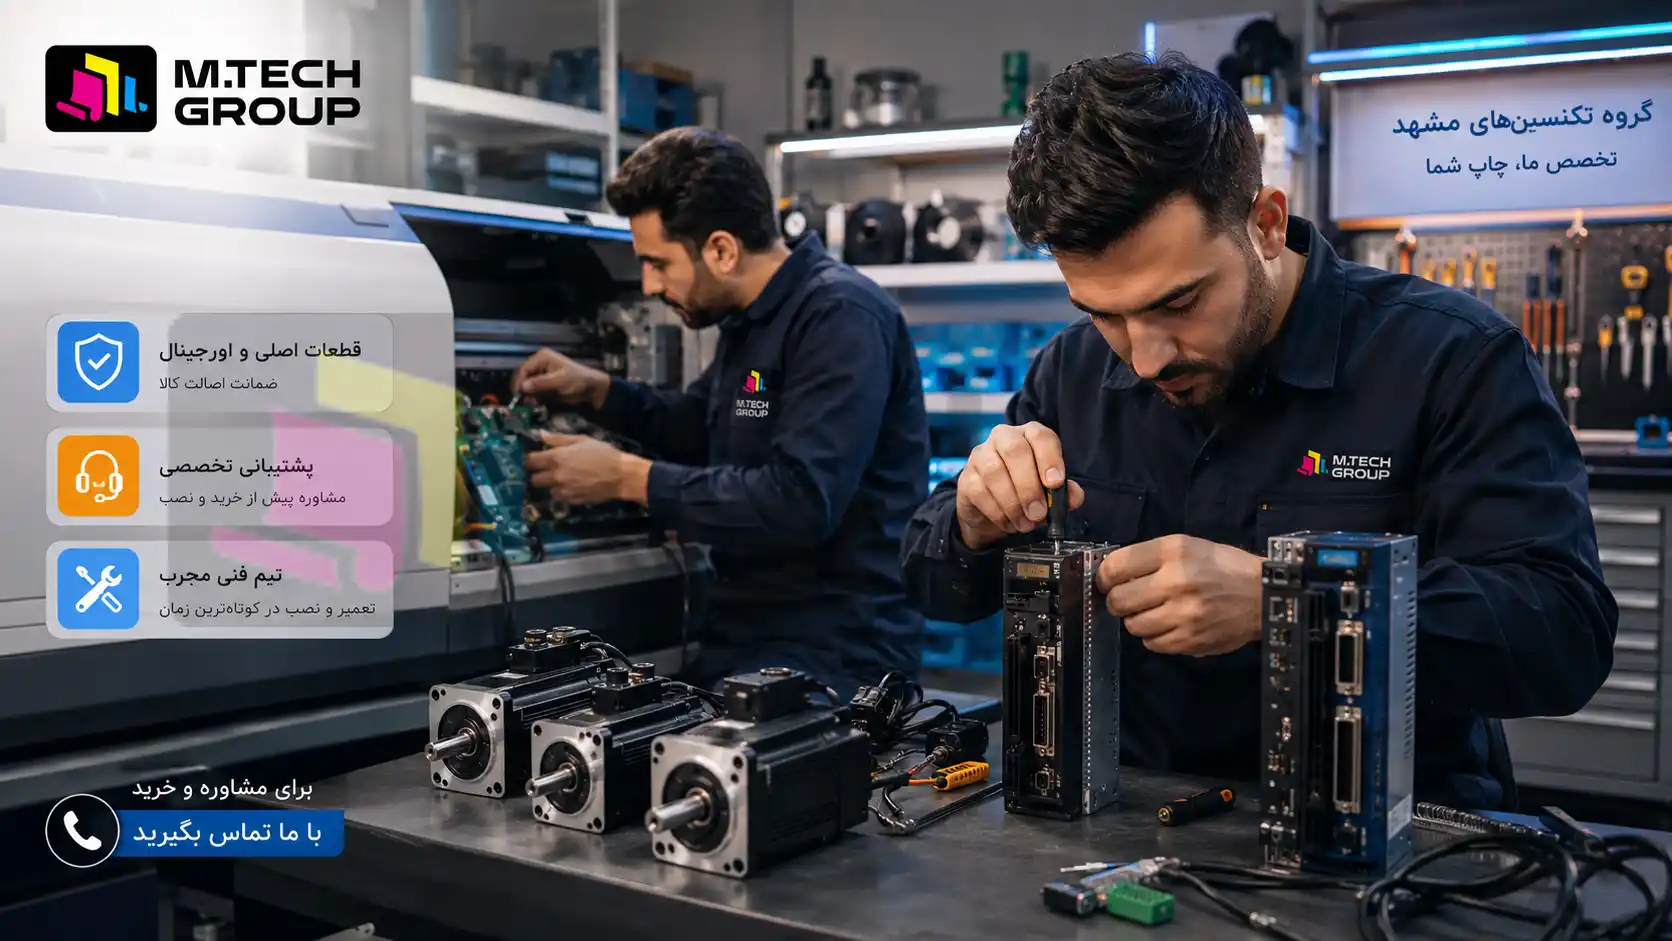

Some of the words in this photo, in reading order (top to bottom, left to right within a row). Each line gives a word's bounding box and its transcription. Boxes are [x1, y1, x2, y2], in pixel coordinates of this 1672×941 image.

[1602, 99, 1653, 130] گروه
[1392, 112, 1460, 139] مشهد
[1426, 156, 1461, 175] شما
[1468, 155, 1508, 179] چاپ
[1515, 154, 1539, 171] ما،
[1546, 151, 1617, 174] تخصص
[736, 408, 769, 417] GROUP
[1332, 454, 1391, 468] M.TECH
[1331, 467, 1390, 480] GROUP
